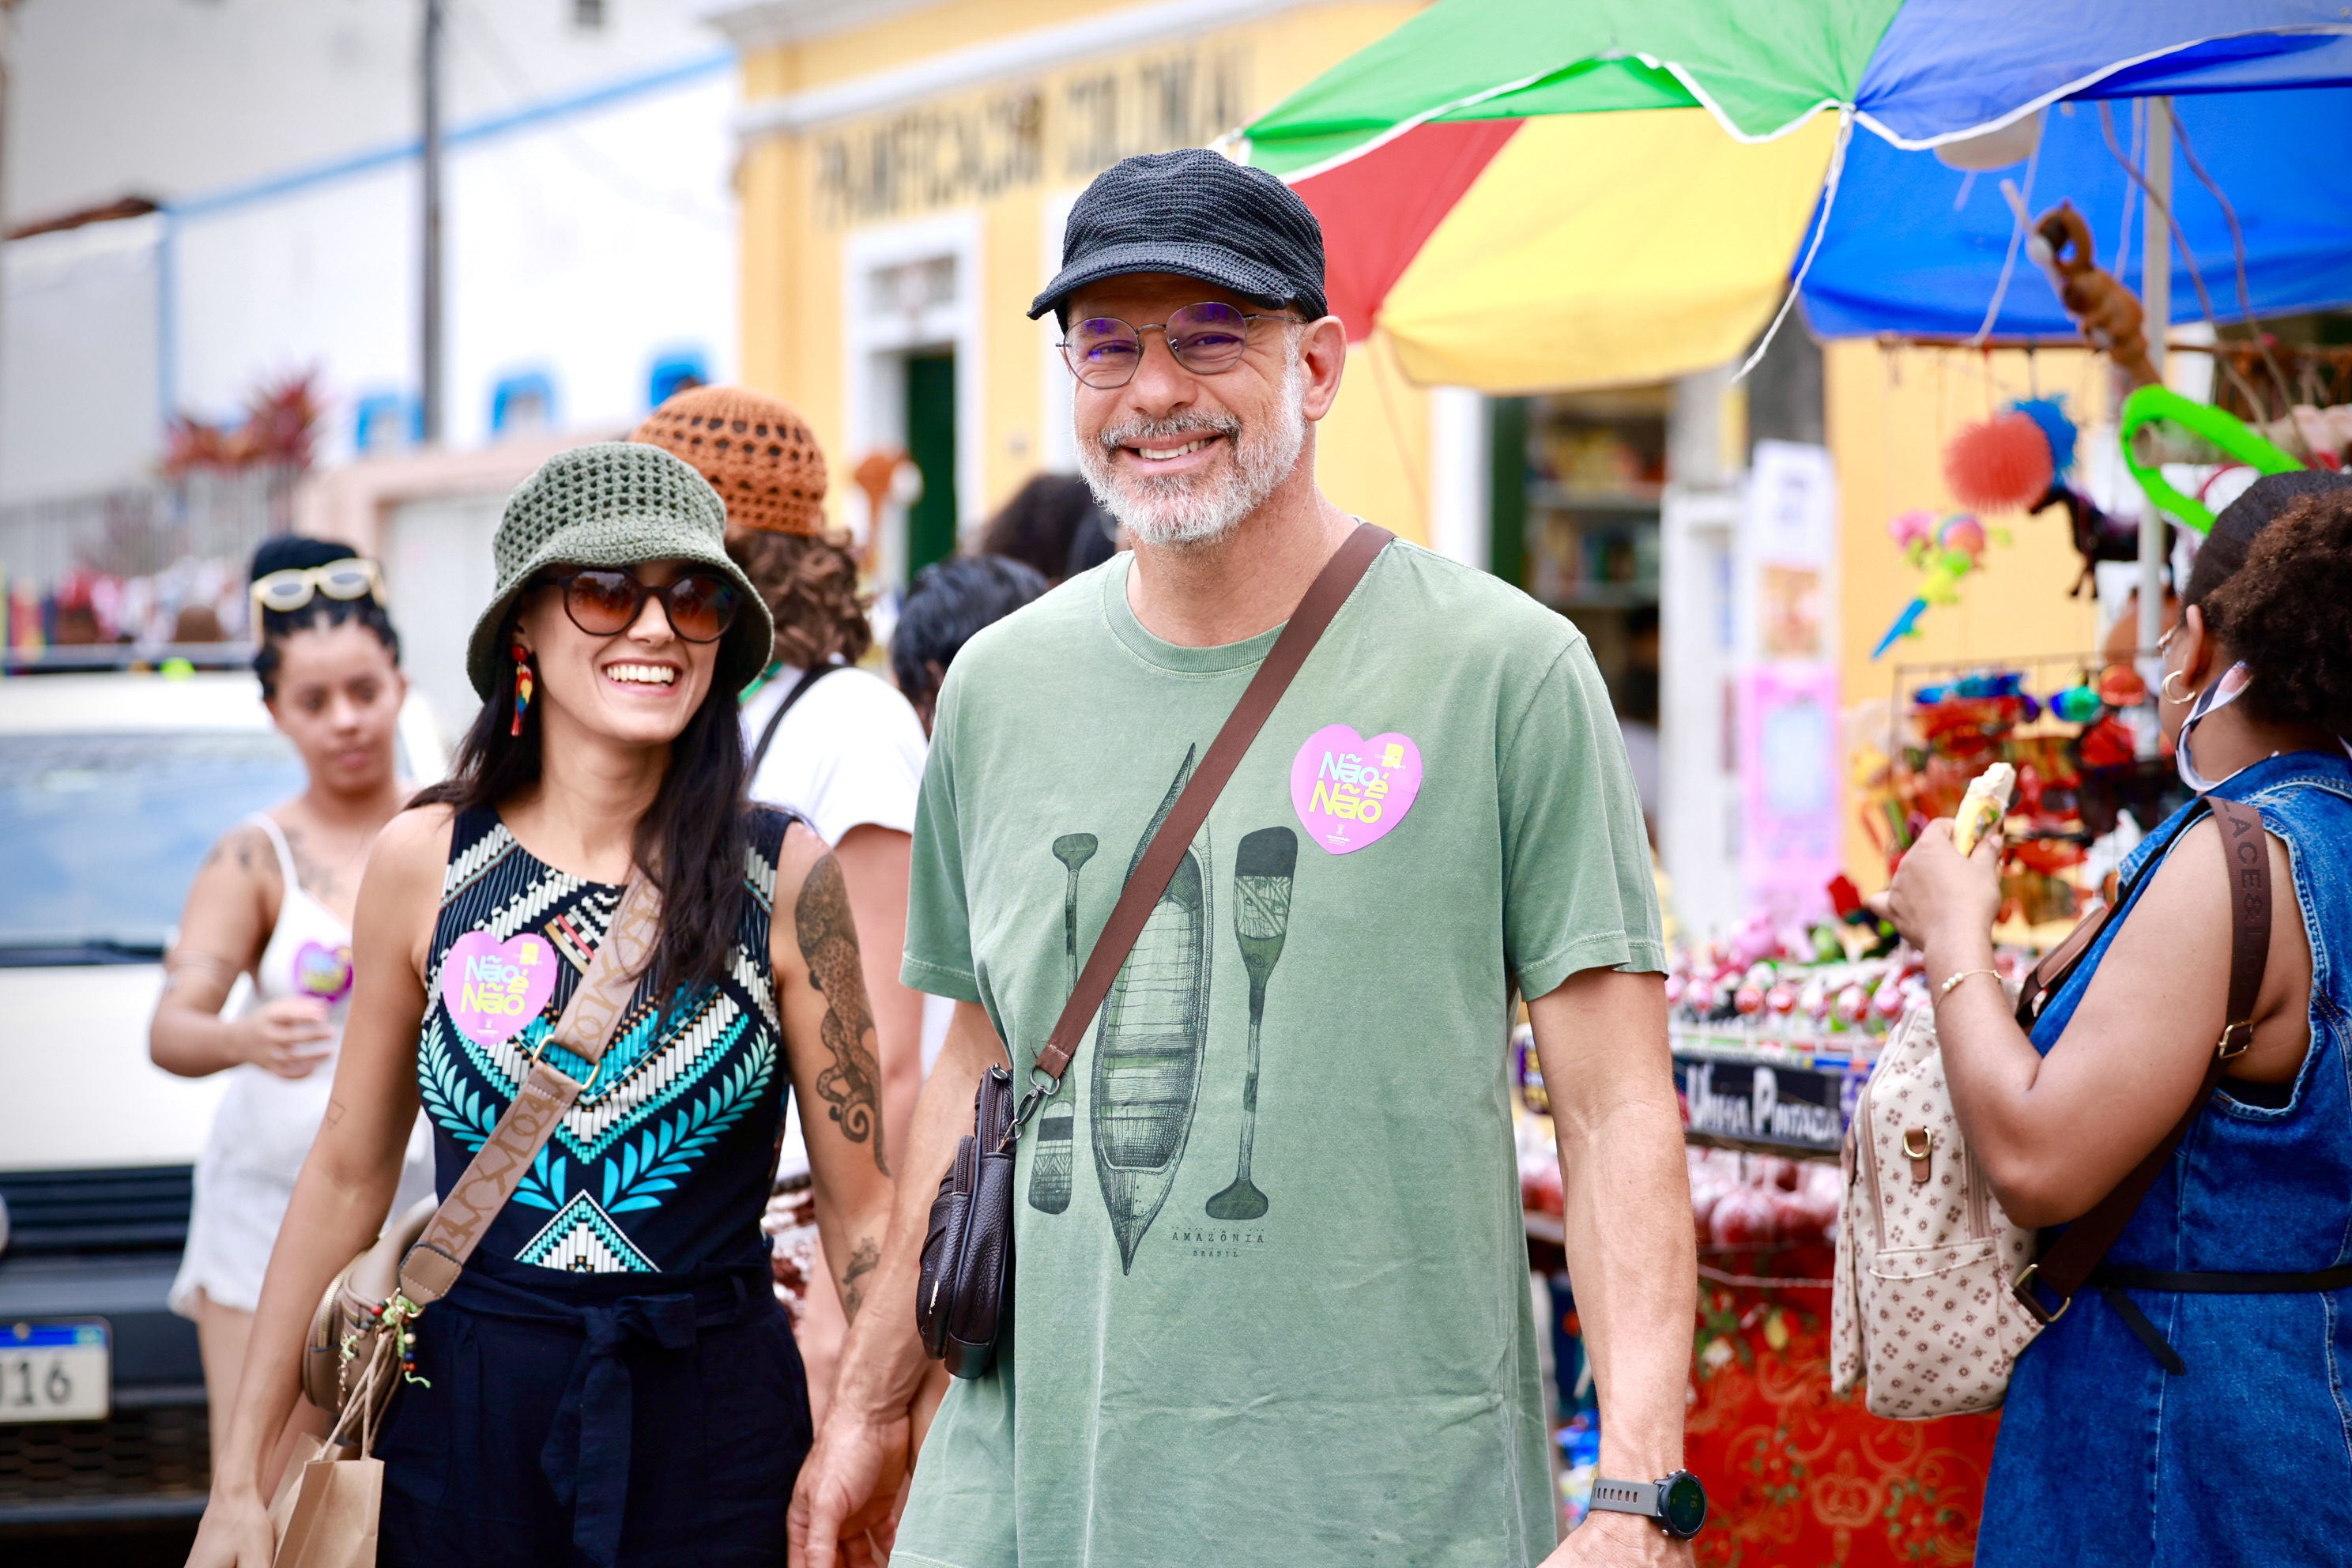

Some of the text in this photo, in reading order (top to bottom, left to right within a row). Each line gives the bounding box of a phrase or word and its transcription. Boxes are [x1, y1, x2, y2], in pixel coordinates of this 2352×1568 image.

[1317, 752, 1380, 786] Não
[1363, 772, 1389, 799] é
[1308, 780, 1382, 824] Não
[465, 955, 519, 983] Não
[507, 968, 530, 995] é
[460, 982, 525, 1016] Não
[1172, 1230, 1264, 1243] AMAZÔNIA
[1193, 1250, 1238, 1258] BRASIL
[0, 1361, 72, 1406] 16
